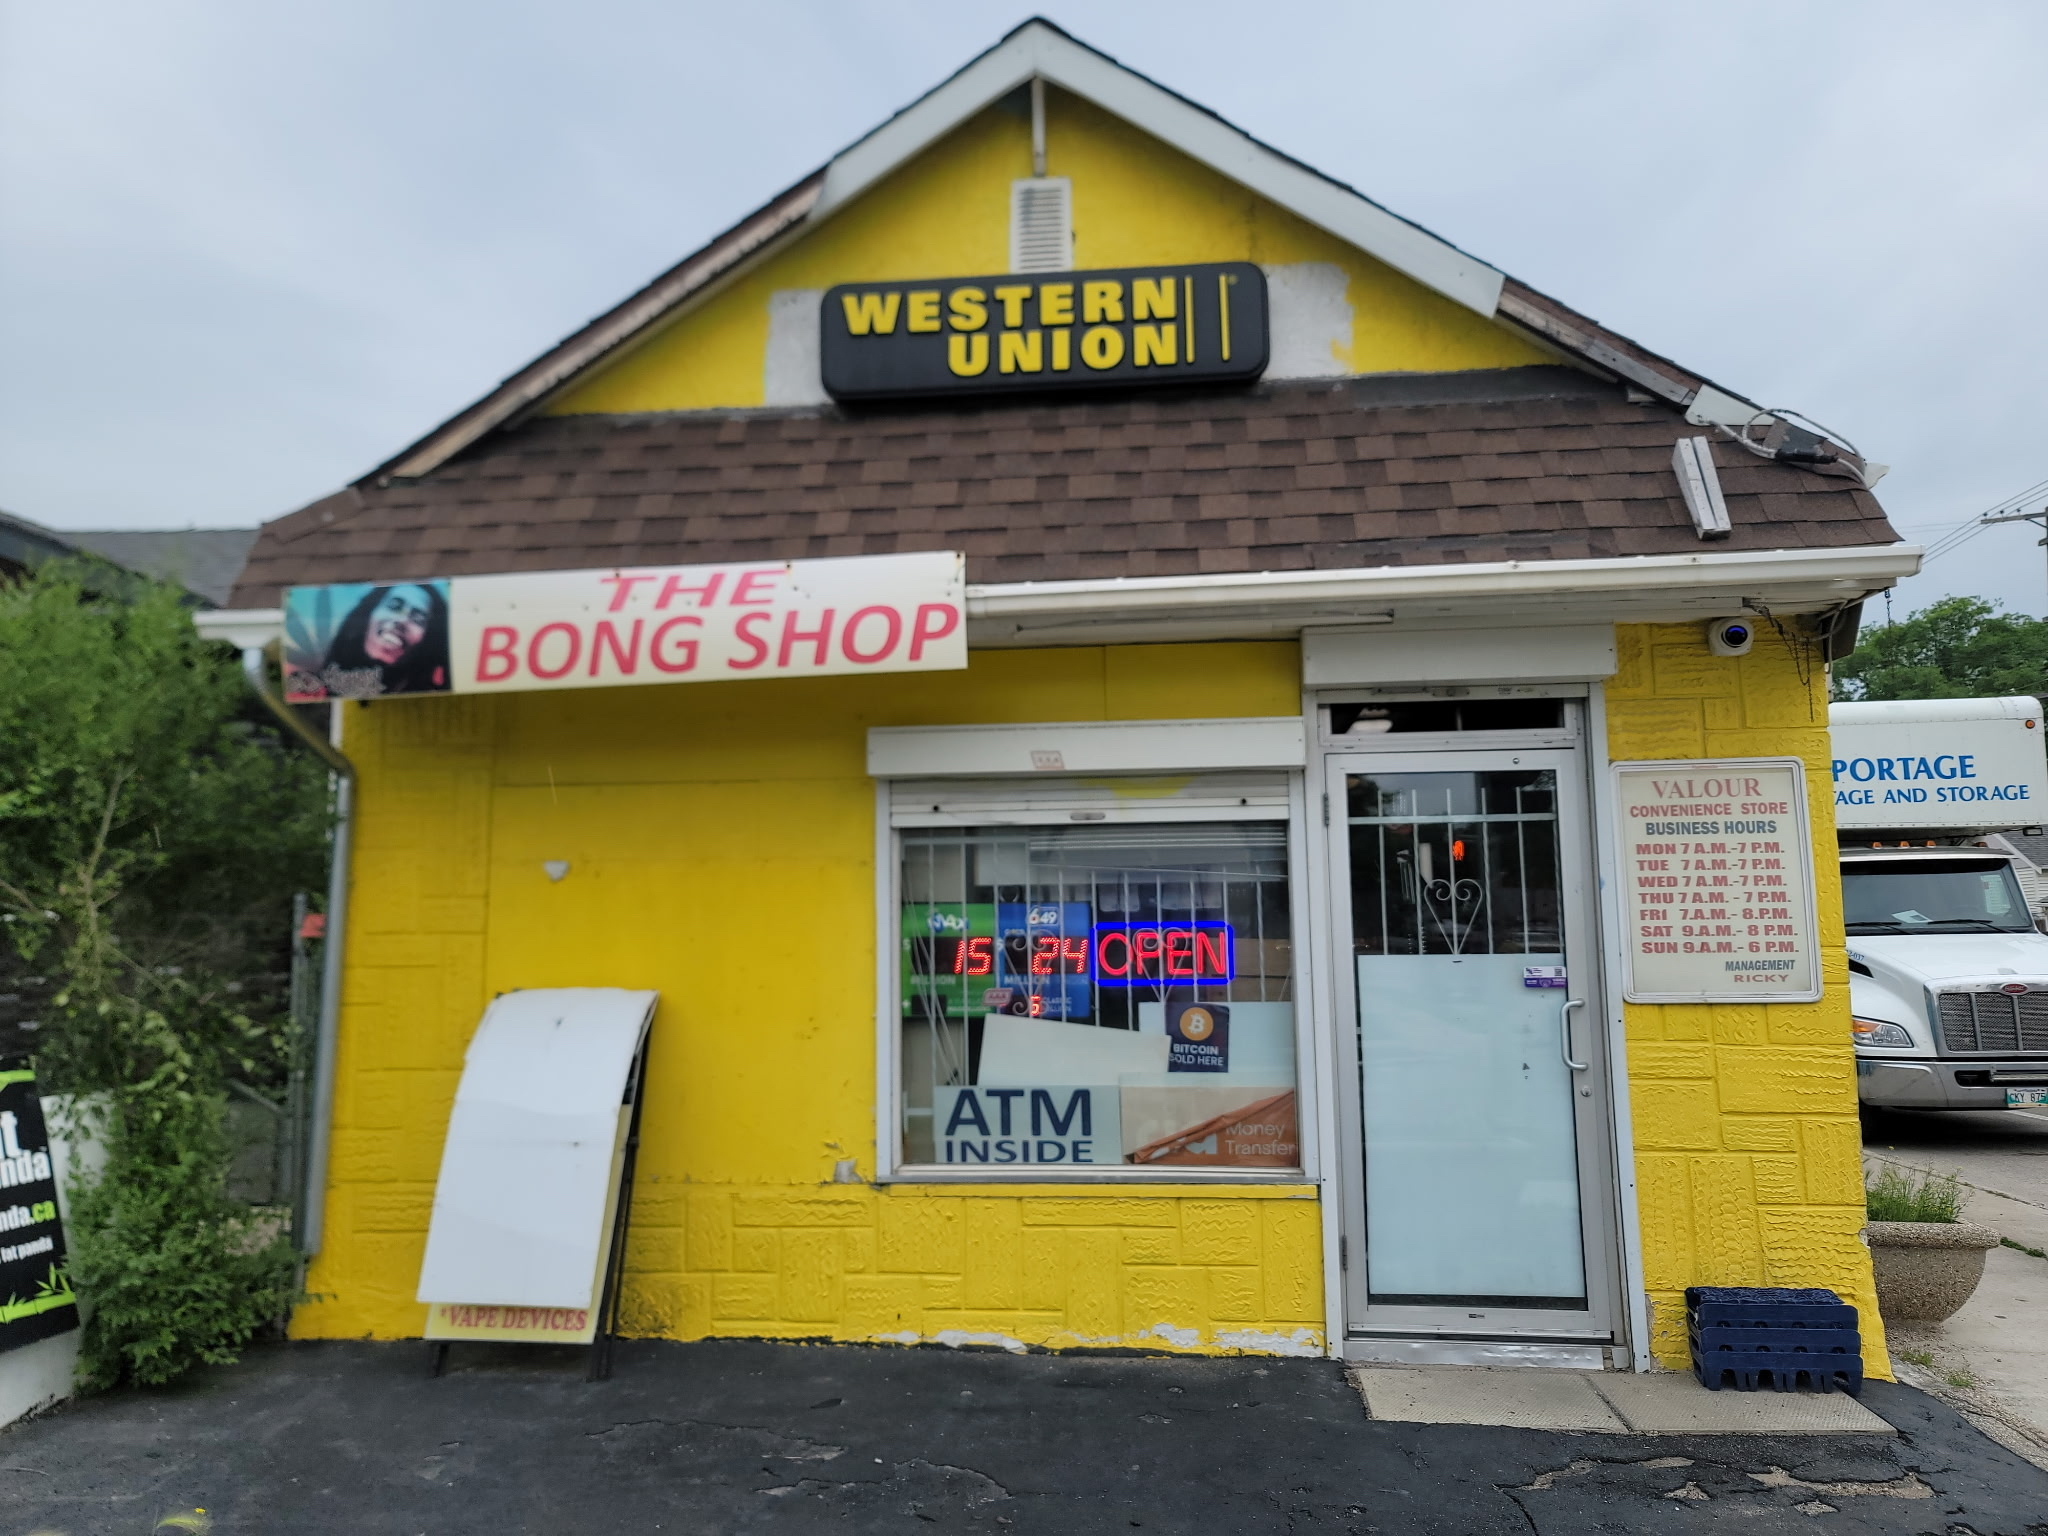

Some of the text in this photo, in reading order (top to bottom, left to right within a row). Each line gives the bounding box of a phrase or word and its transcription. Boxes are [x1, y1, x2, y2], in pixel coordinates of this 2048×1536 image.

[841, 276, 1178, 336] WESTERN
[947, 323, 1178, 377] UNION
[600, 569, 789, 612] THE
[475, 602, 959, 684] BONG SHOP
[1832, 755, 1976, 782] PORTAGE
[1651, 777, 1763, 799] VALOUR
[1834, 784, 2030, 805] AGE AND STORAGE
[1630, 802, 1788, 818] CONVENIENCE STORE
[1645, 820, 1777, 836] BUSINESS HOURS
[1636, 843, 1676, 855] MON
[1680, 843, 1690, 854] 7
[1751, 842, 1785, 853] P.M.
[1636, 859, 1669, 871] TUE
[1681, 859, 1690, 870] 7
[1752, 858, 1786, 870] P.M.
[1637, 876, 1678, 887] WED
[1682, 876, 1692, 887] 7
[1753, 875, 1788, 886] P.M.
[1638, 892, 1674, 904] THU
[1678, 892, 1688, 904] 7
[1691, 892, 1730, 904] A.M.
[1744, 891, 1753, 903] 7
[1757, 891, 1792, 903] P.M.
[1640, 909, 1668, 920] FRI
[1640, 925, 1673, 937] SAT
[1747, 924, 1759, 936] 8
[1764, 924, 1799, 936] P.M.
[1099, 932, 1226, 976] OPEN
[1641, 942, 1678, 953] SUN
[1748, 941, 1760, 953] 6
[1765, 941, 1800, 953] P.M.
[954, 937, 994, 975] 15
[1032, 937, 1089, 974] 24
[1725, 960, 1796, 972] MANAGEMENT
[1734, 974, 1789, 983] RICKY
[1173, 1043, 1219, 1056] BITCOIN
[1169, 1053, 1224, 1066] SOLD HERE
[2010, 1092, 2047, 1103] CKY 875
[945, 1089, 1092, 1136] ATM
[1225, 1122, 1285, 1138] Money
[946, 1140, 1093, 1163] INSIDE
[1225, 1140, 1296, 1155] Transfer
[502, 1307, 588, 1331] DEVICES
